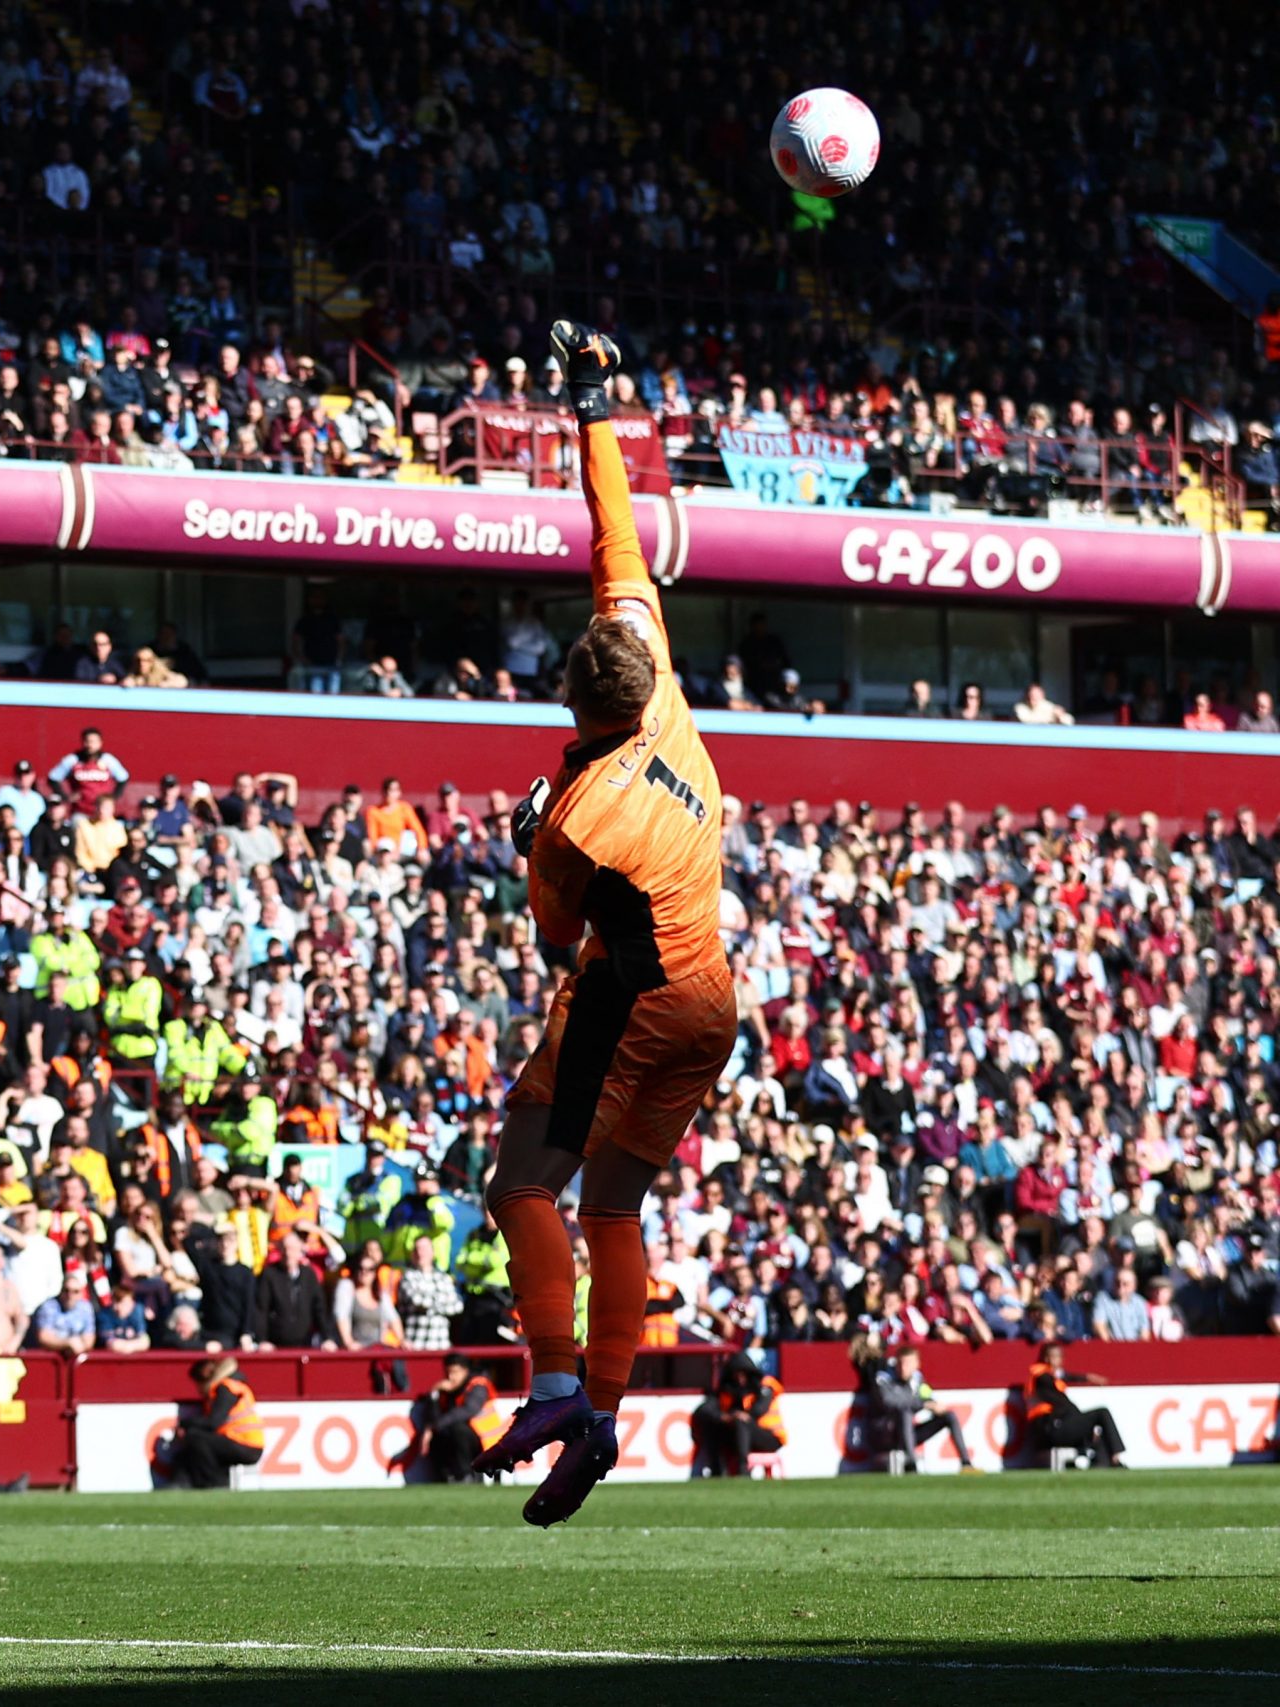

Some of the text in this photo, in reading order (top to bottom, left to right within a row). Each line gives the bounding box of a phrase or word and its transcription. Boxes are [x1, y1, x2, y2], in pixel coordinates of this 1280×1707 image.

[721, 426, 864, 463] ASTON VILLA
[183, 499, 569, 557] Search. Drive. Smile.
[841, 527, 1062, 592] CAZOO
[607, 716, 659, 788] LENO
[644, 754, 706, 826] 1
[145, 1415, 416, 1475] ZOO
